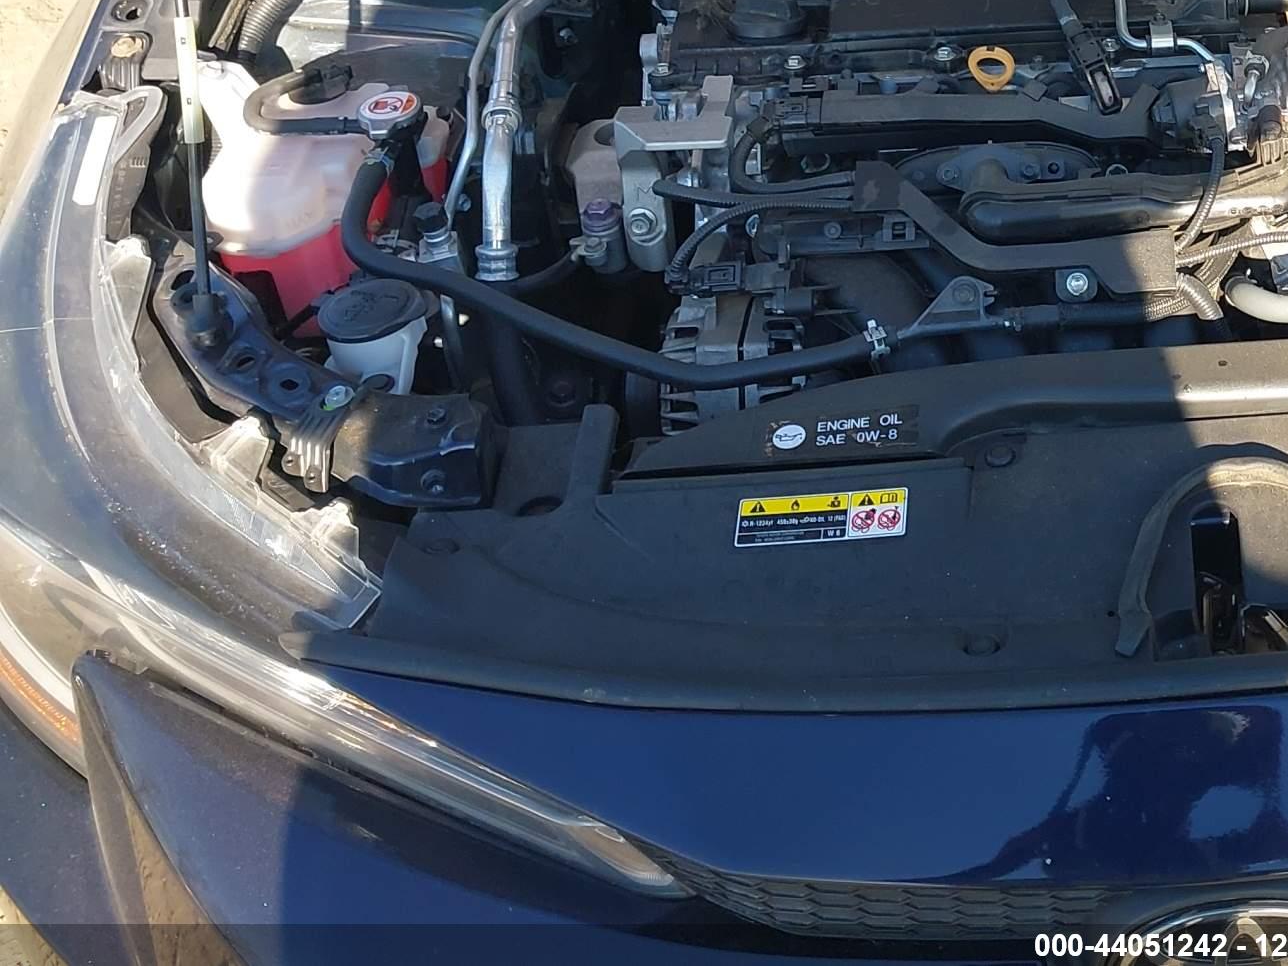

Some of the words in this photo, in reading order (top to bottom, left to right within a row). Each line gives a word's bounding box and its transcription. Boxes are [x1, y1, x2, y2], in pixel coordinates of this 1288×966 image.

[817, 417, 871, 433] ENGINE
[879, 413, 903, 426] OIL
[816, 433, 846, 446] SAE
[856, 428, 898, 443] 0W-8
